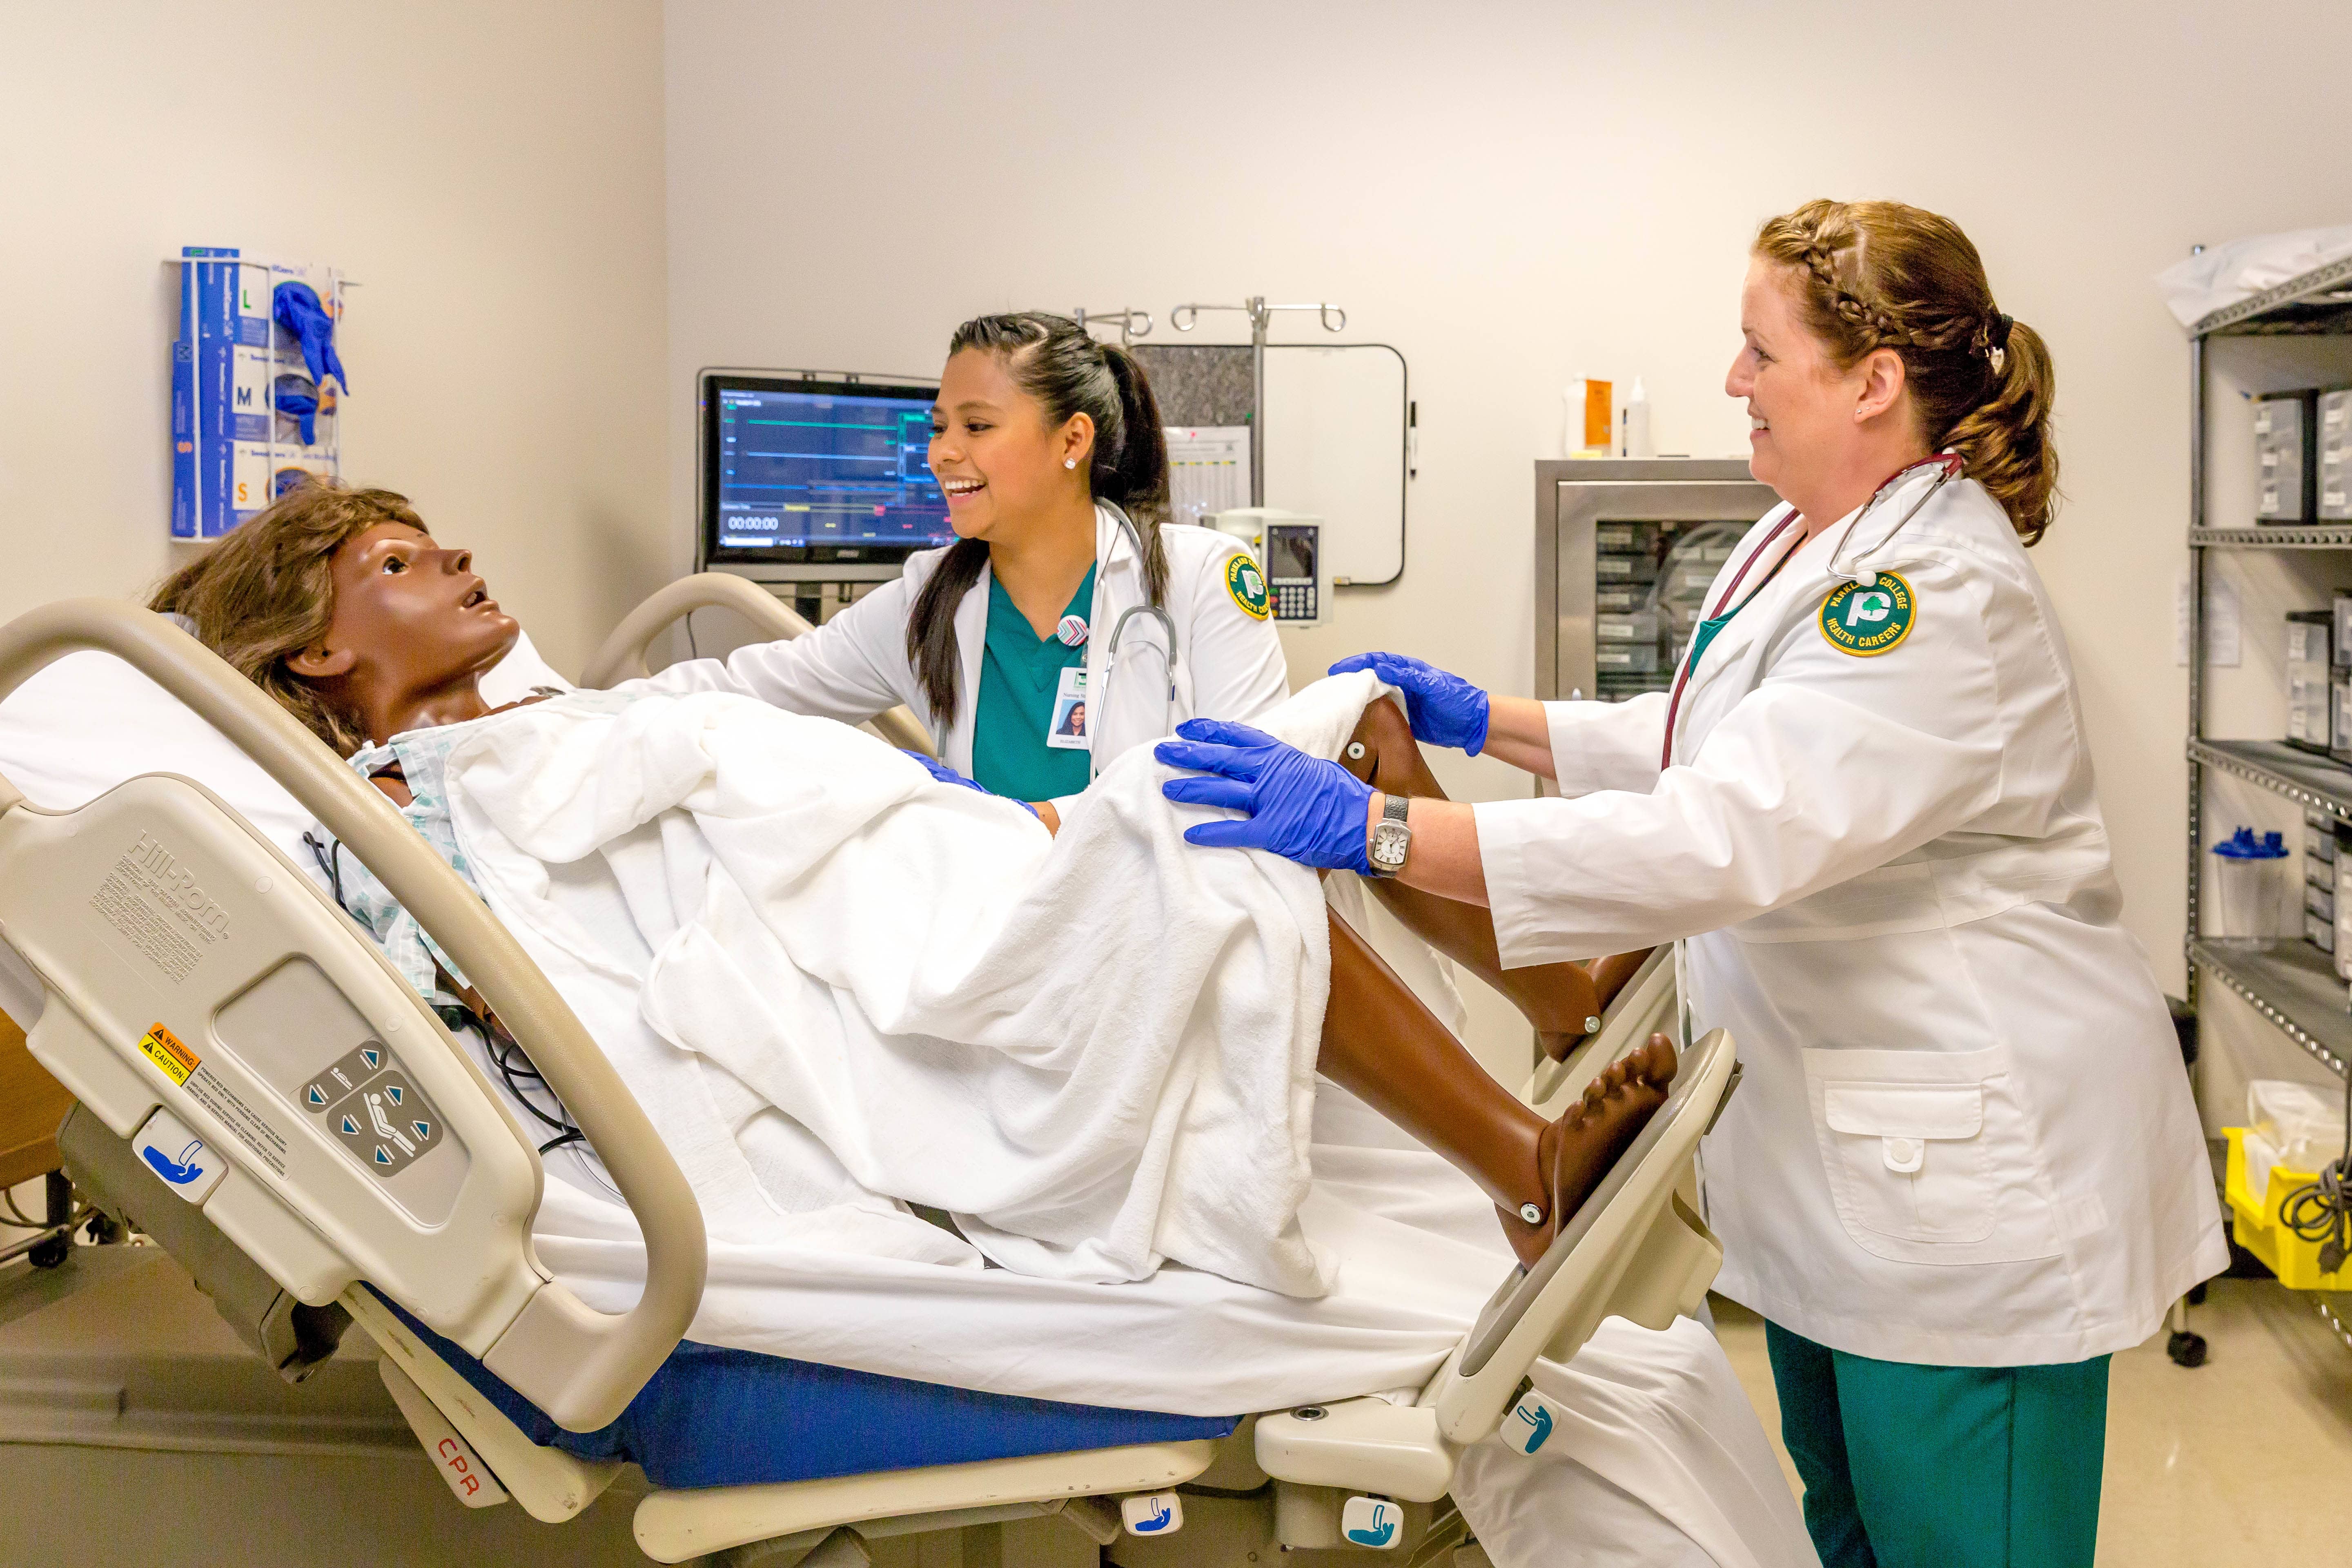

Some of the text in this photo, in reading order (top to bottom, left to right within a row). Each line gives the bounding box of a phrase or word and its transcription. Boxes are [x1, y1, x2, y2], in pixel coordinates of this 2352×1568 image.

[243, 289, 252, 309] L
[237, 387, 251, 407] M
[238, 483, 247, 502] S
[728, 517, 779, 530] 00:00:00
[1236, 591, 1257, 612] HEALTH
[1830, 577, 1908, 610] PARKL COLLEGE
[1827, 617, 1902, 646] HEALTH CAREERS
[154, 1050, 185, 1080] CAUTION:
[165, 1036, 195, 1067] WARNING:
[197, 1071, 212, 1086] OPERATE
[218, 1091, 227, 1100] ONLY
[227, 1098, 236, 1108] WITH
[235, 1107, 250, 1121] PERSONS
[250, 1120, 261, 1131] CLEAR
[265, 1134, 286, 1154] MECHANISMS.
[200, 1067, 217, 1082] POWERED
[223, 1087, 244, 1107] MECHANISMS
[251, 1112, 262, 1123] CAUSE
[261, 1122, 275, 1136] SERIOUS
[186, 1085, 199, 1099] MANUAL
[224, 1120, 237, 1134] MANUAL
[244, 1139, 263, 1157] ADDITIONAL
[190, 1080, 204, 1094] UNPLUG
[209, 1098, 223, 1111] DURING
[222, 1110, 236, 1123] SERVICE
[256, 1141, 267, 1152] REFER
[272, 1155, 286, 1169] SERVICE
[438, 1438, 479, 1496] CPR
